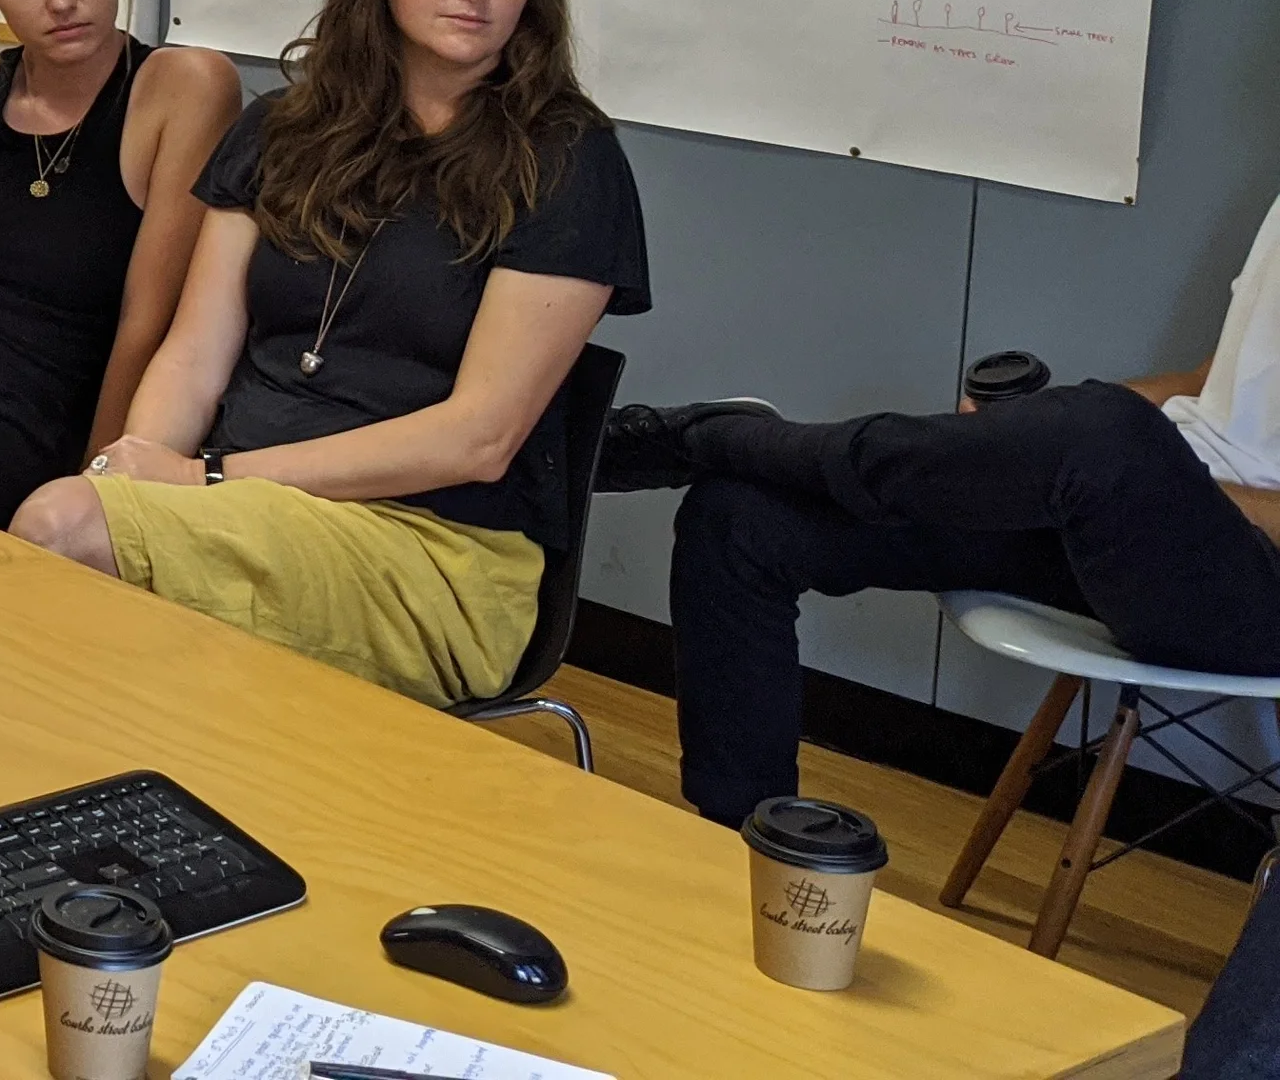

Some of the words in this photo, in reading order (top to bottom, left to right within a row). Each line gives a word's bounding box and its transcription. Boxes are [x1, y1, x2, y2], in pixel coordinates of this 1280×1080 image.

[790, 918, 826, 935] street
[825, 918, 858, 945] bakery
[96, 1019, 131, 1036] street
